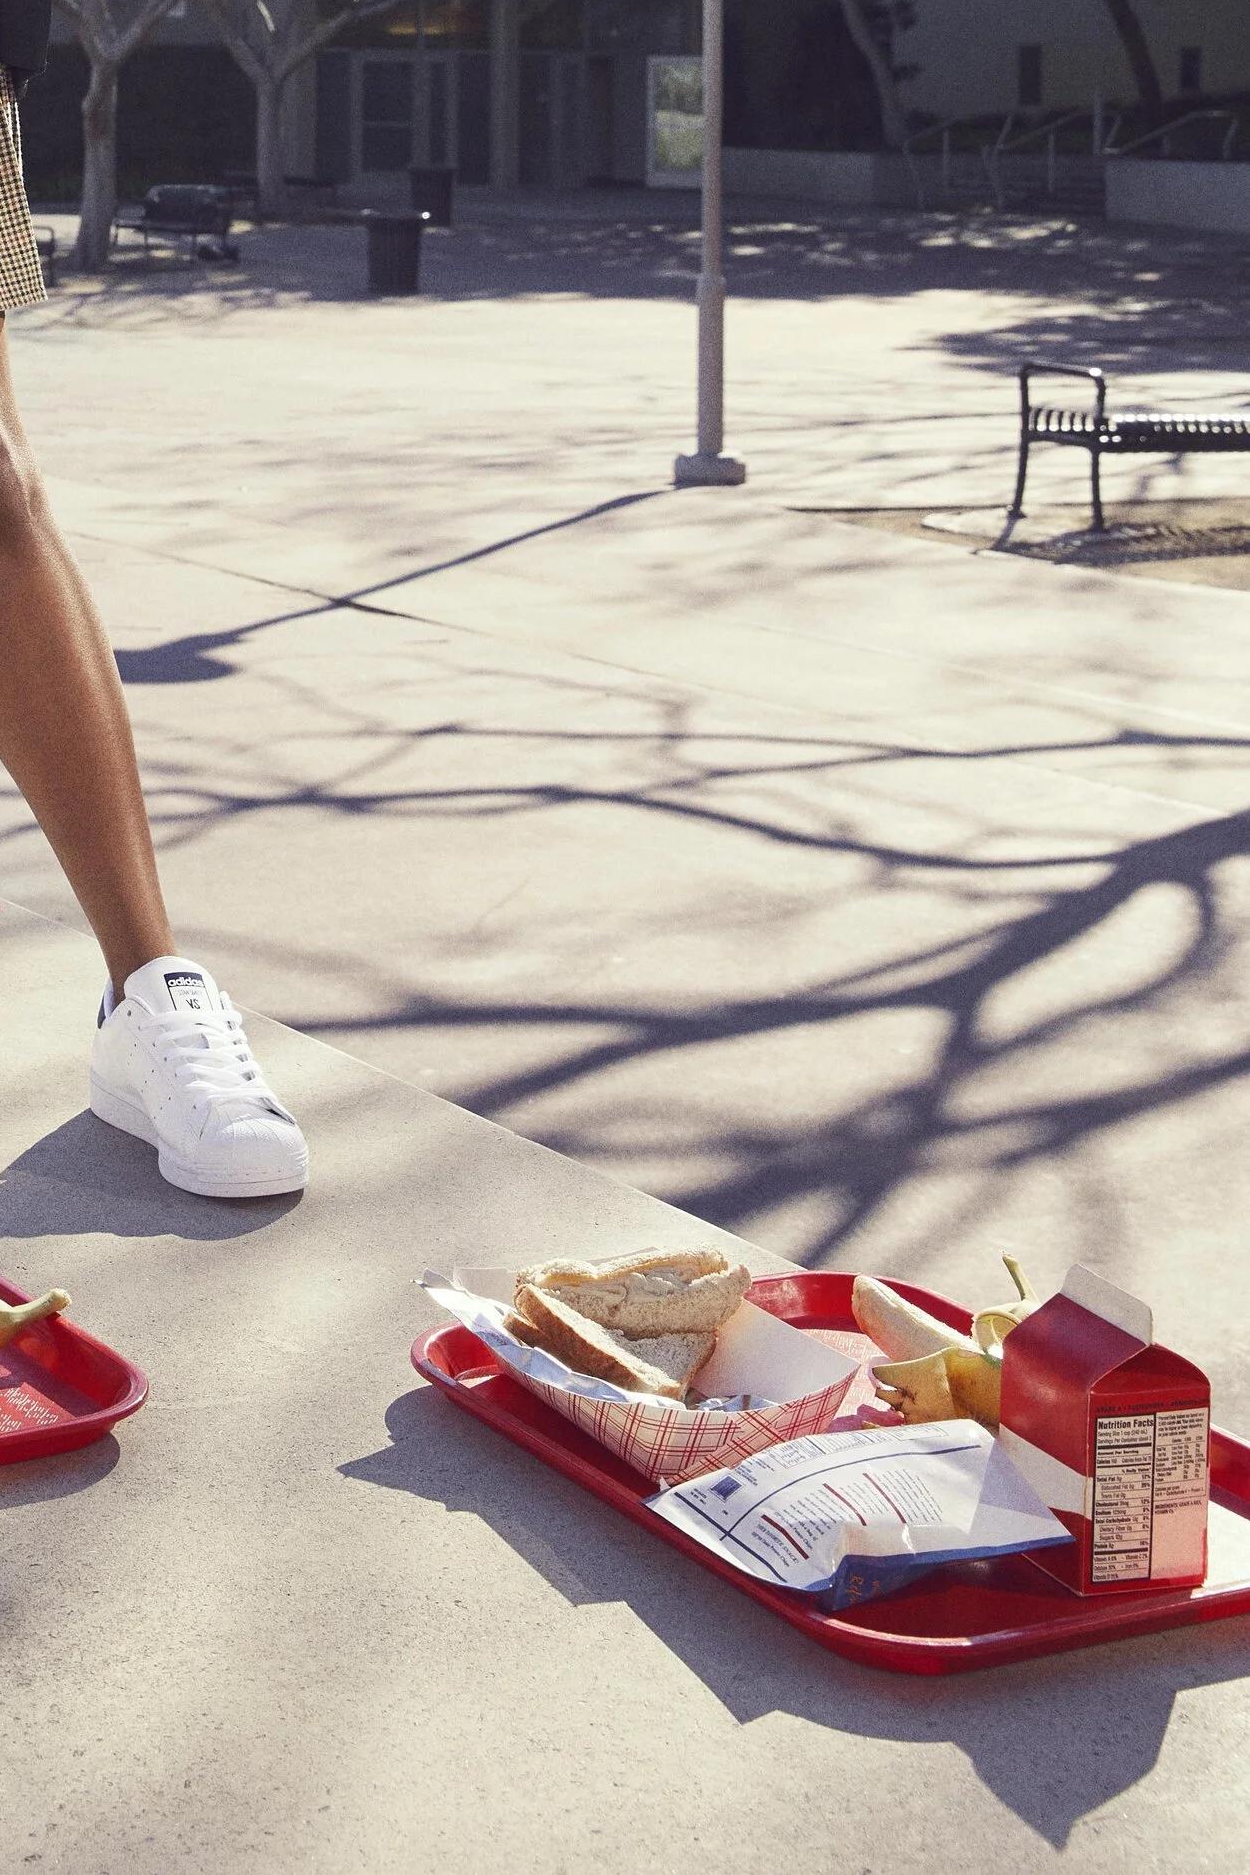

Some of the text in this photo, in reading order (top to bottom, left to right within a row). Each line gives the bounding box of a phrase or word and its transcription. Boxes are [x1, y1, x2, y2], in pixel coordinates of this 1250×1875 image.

[167, 976, 204, 987] adidas
[185, 998, 201, 1010] VS
[1098, 1419, 1154, 1429] Nutrition Facts
